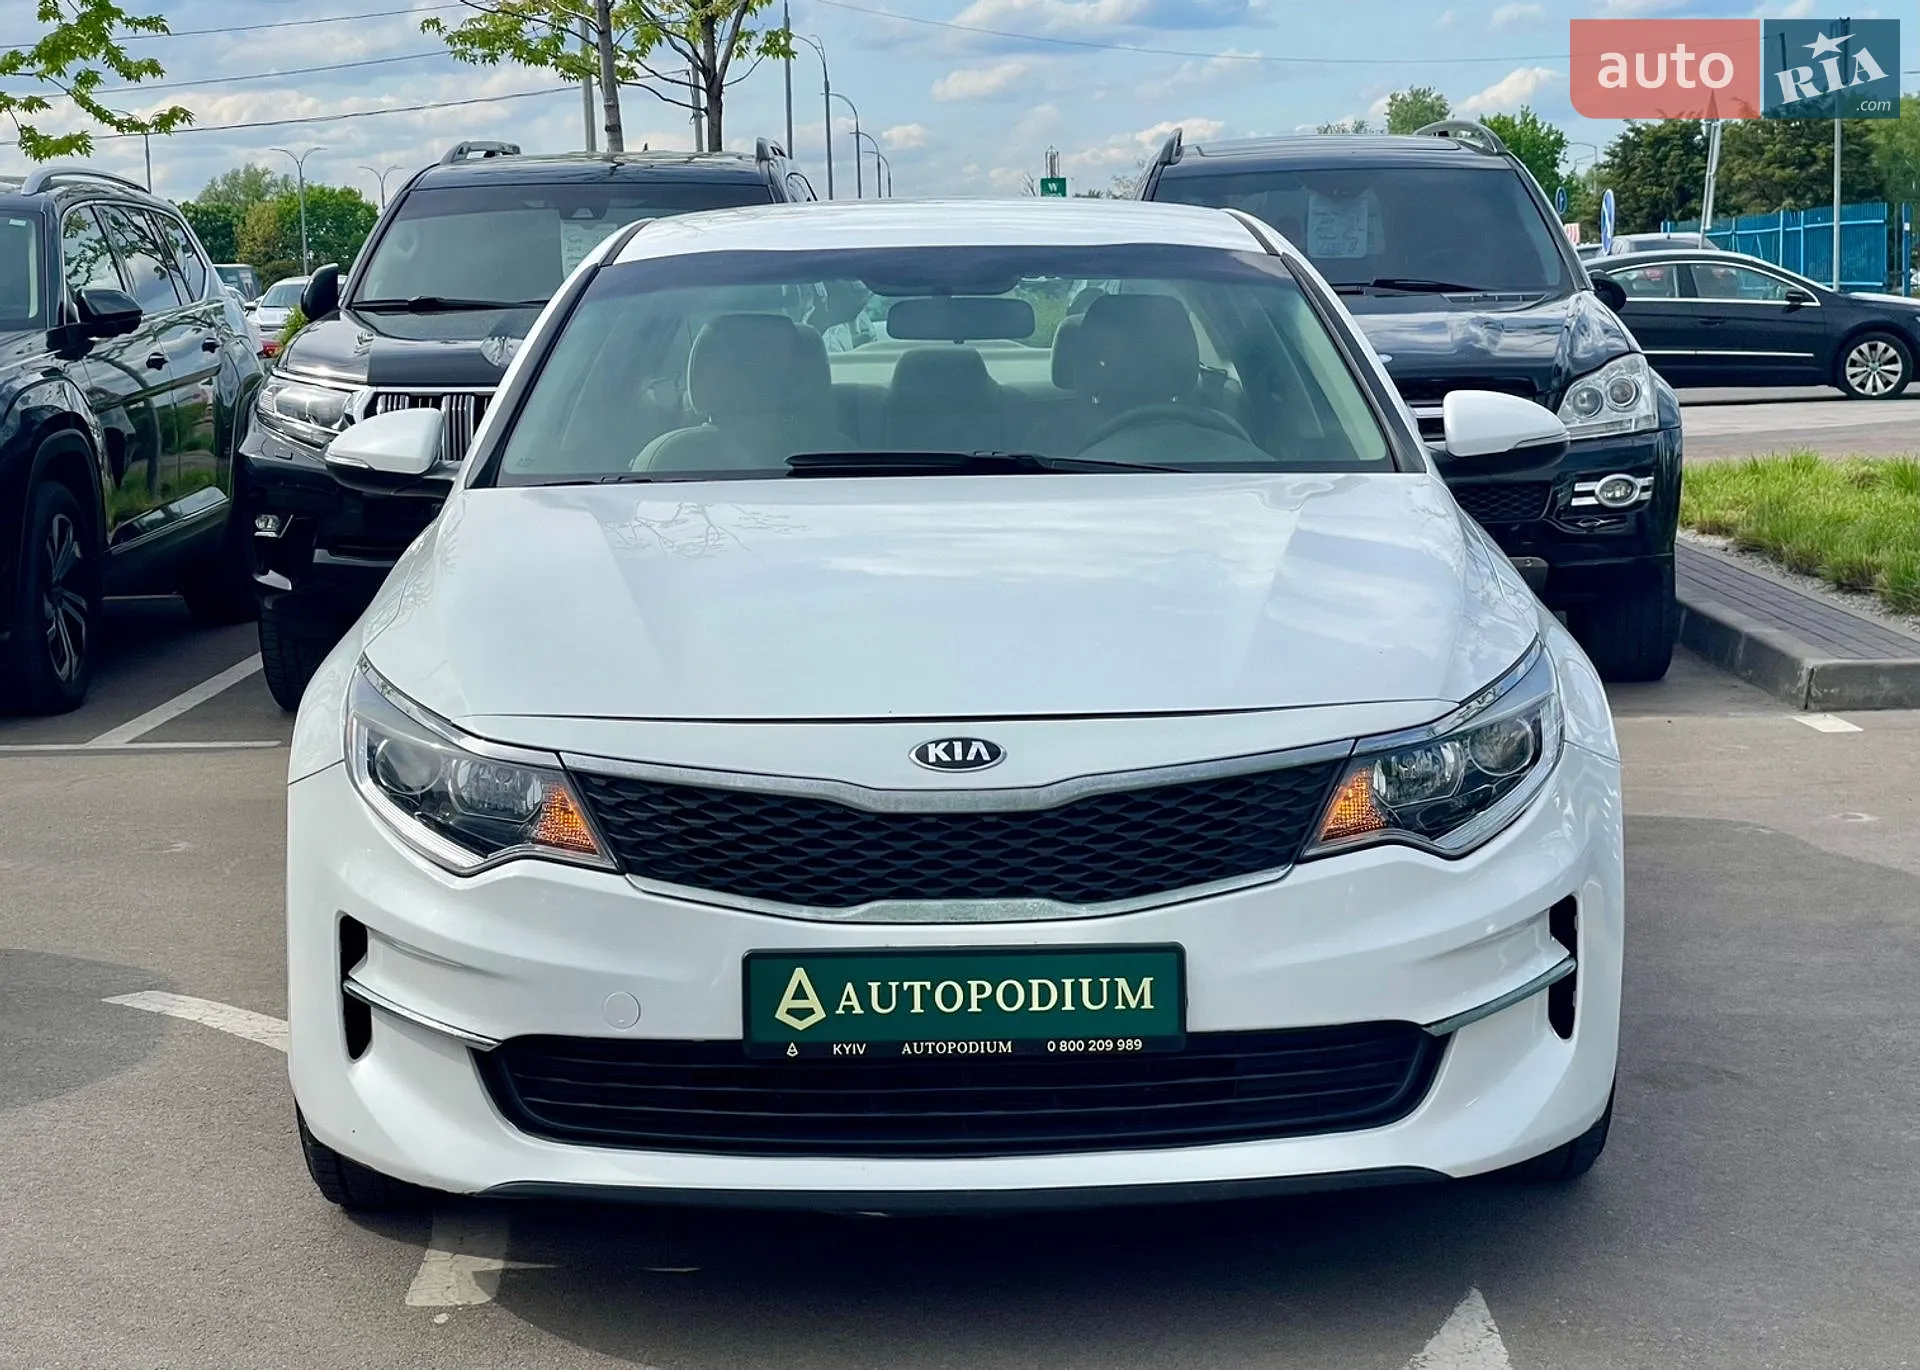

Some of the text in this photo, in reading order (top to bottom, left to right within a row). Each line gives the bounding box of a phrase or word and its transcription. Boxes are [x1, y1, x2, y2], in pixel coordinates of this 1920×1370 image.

[927, 741, 991, 763] KIA
[835, 976, 1155, 1015] AUTOPODIUM
[832, 1038, 1143, 1056] KYIV AUTOPODIUM 0 800 209 989
